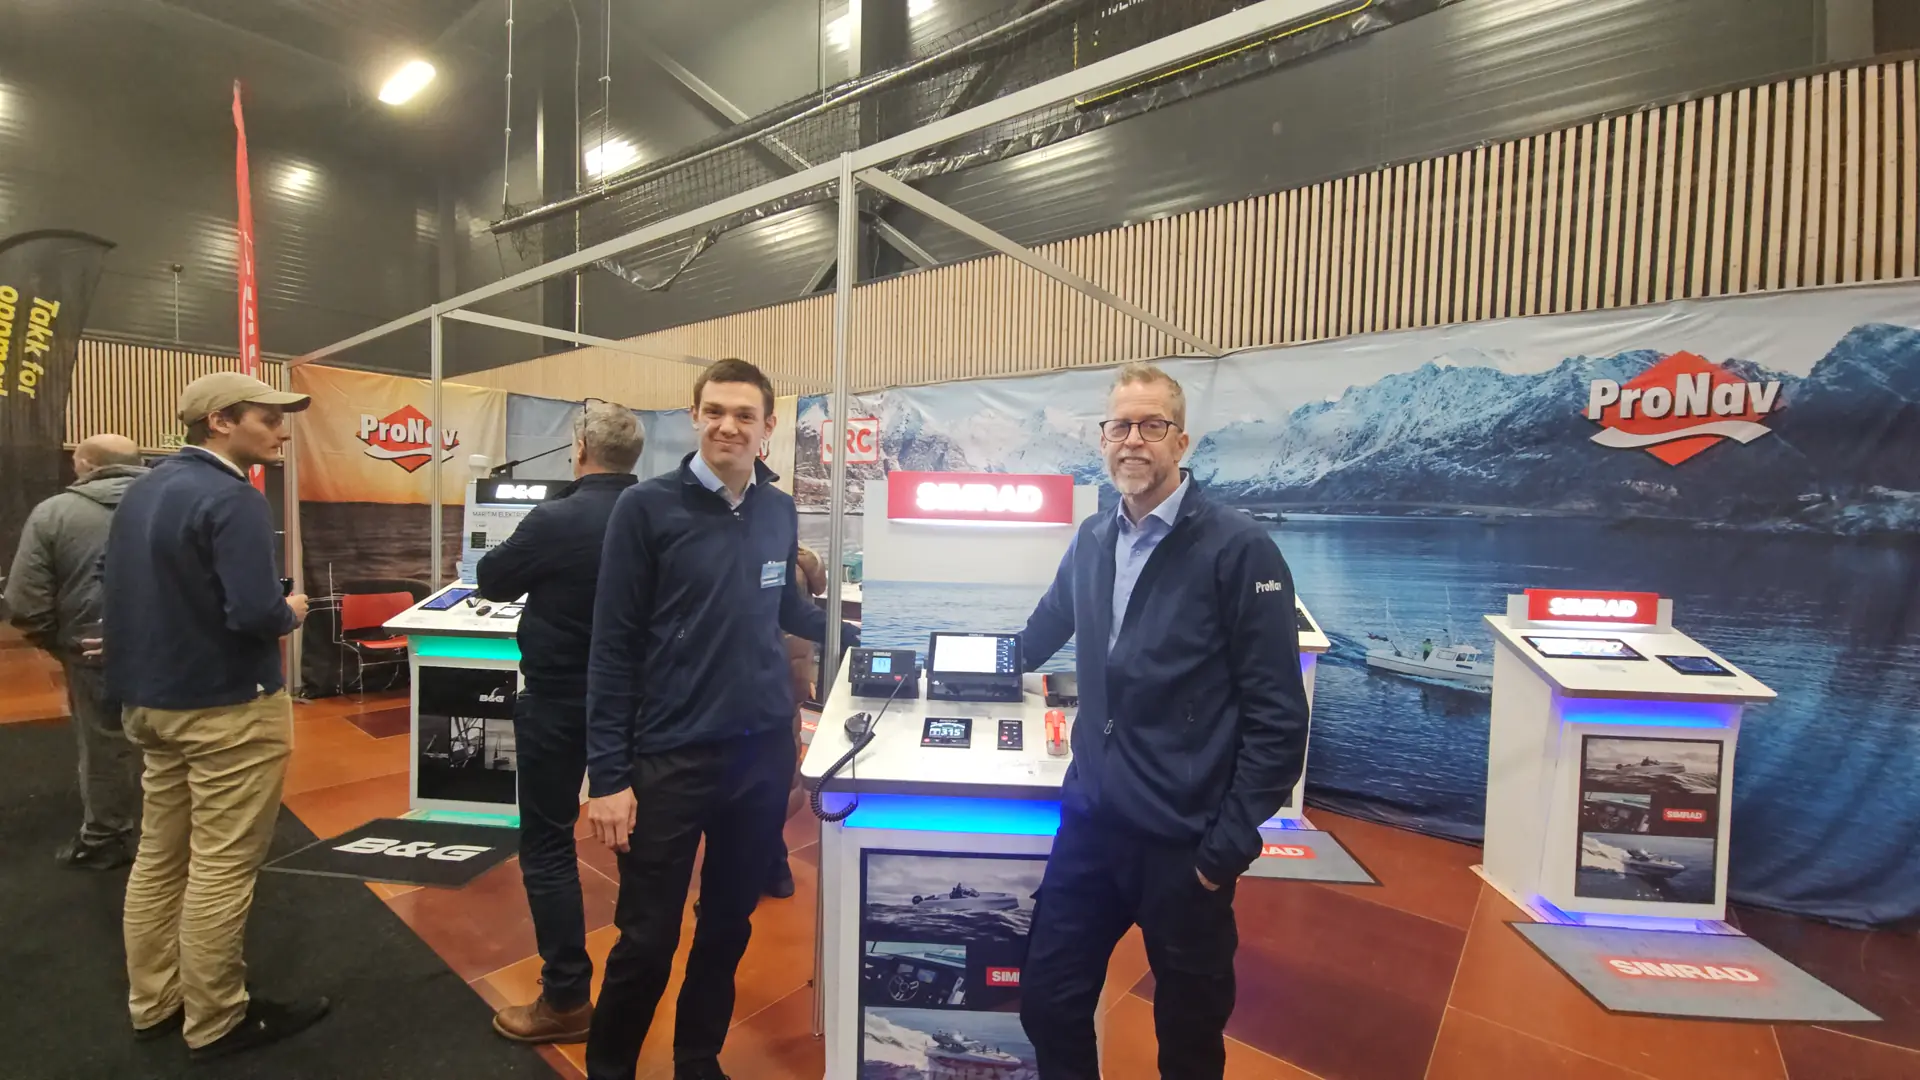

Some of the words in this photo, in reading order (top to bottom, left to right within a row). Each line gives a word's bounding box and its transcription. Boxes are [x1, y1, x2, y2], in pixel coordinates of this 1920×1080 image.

[24, 297, 61, 358] Takk
[18, 360, 45, 400] for
[1588, 372, 1781, 420] ProNav
[826, 428, 873, 454] RC
[916, 482, 1043, 513] SIMRAD
[1548, 597, 1638, 617] SIMRAD
[479, 688, 505, 702] B&G
[1666, 810, 1703, 819] SIMRAD
[332, 837, 492, 861] B&G
[992, 971, 1020, 983] SIM
[1609, 959, 1760, 983] SIMRAD
